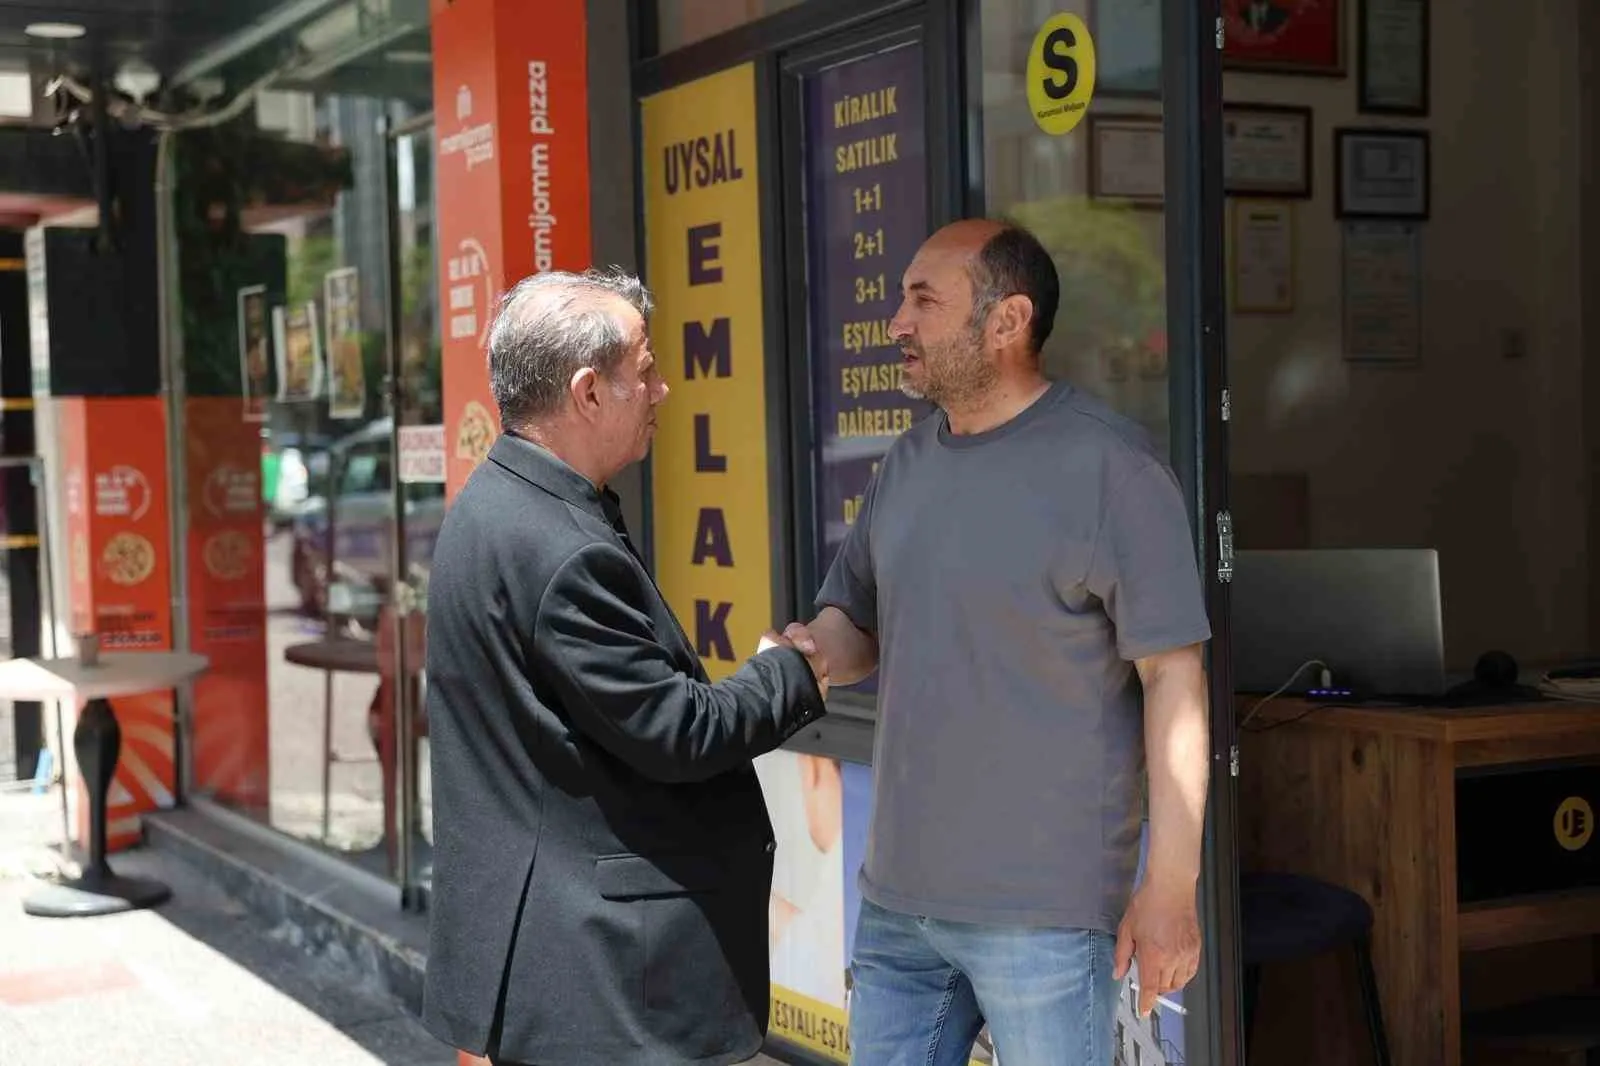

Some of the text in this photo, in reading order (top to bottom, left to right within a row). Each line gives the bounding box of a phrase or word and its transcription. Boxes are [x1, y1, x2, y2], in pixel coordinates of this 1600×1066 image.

[1042, 28, 1078, 100] S
[527, 60, 555, 134] pizza
[833, 86, 897, 129] KİRALIK
[664, 128, 743, 195] UYSAL
[834, 132, 898, 174] SATILIK
[852, 183, 883, 214] 1+1
[853, 228, 884, 260] 2+1
[855, 273, 886, 304] 3+1
[843, 319, 897, 353] EŞYAL
[837, 406, 913, 438] DAİRELER
